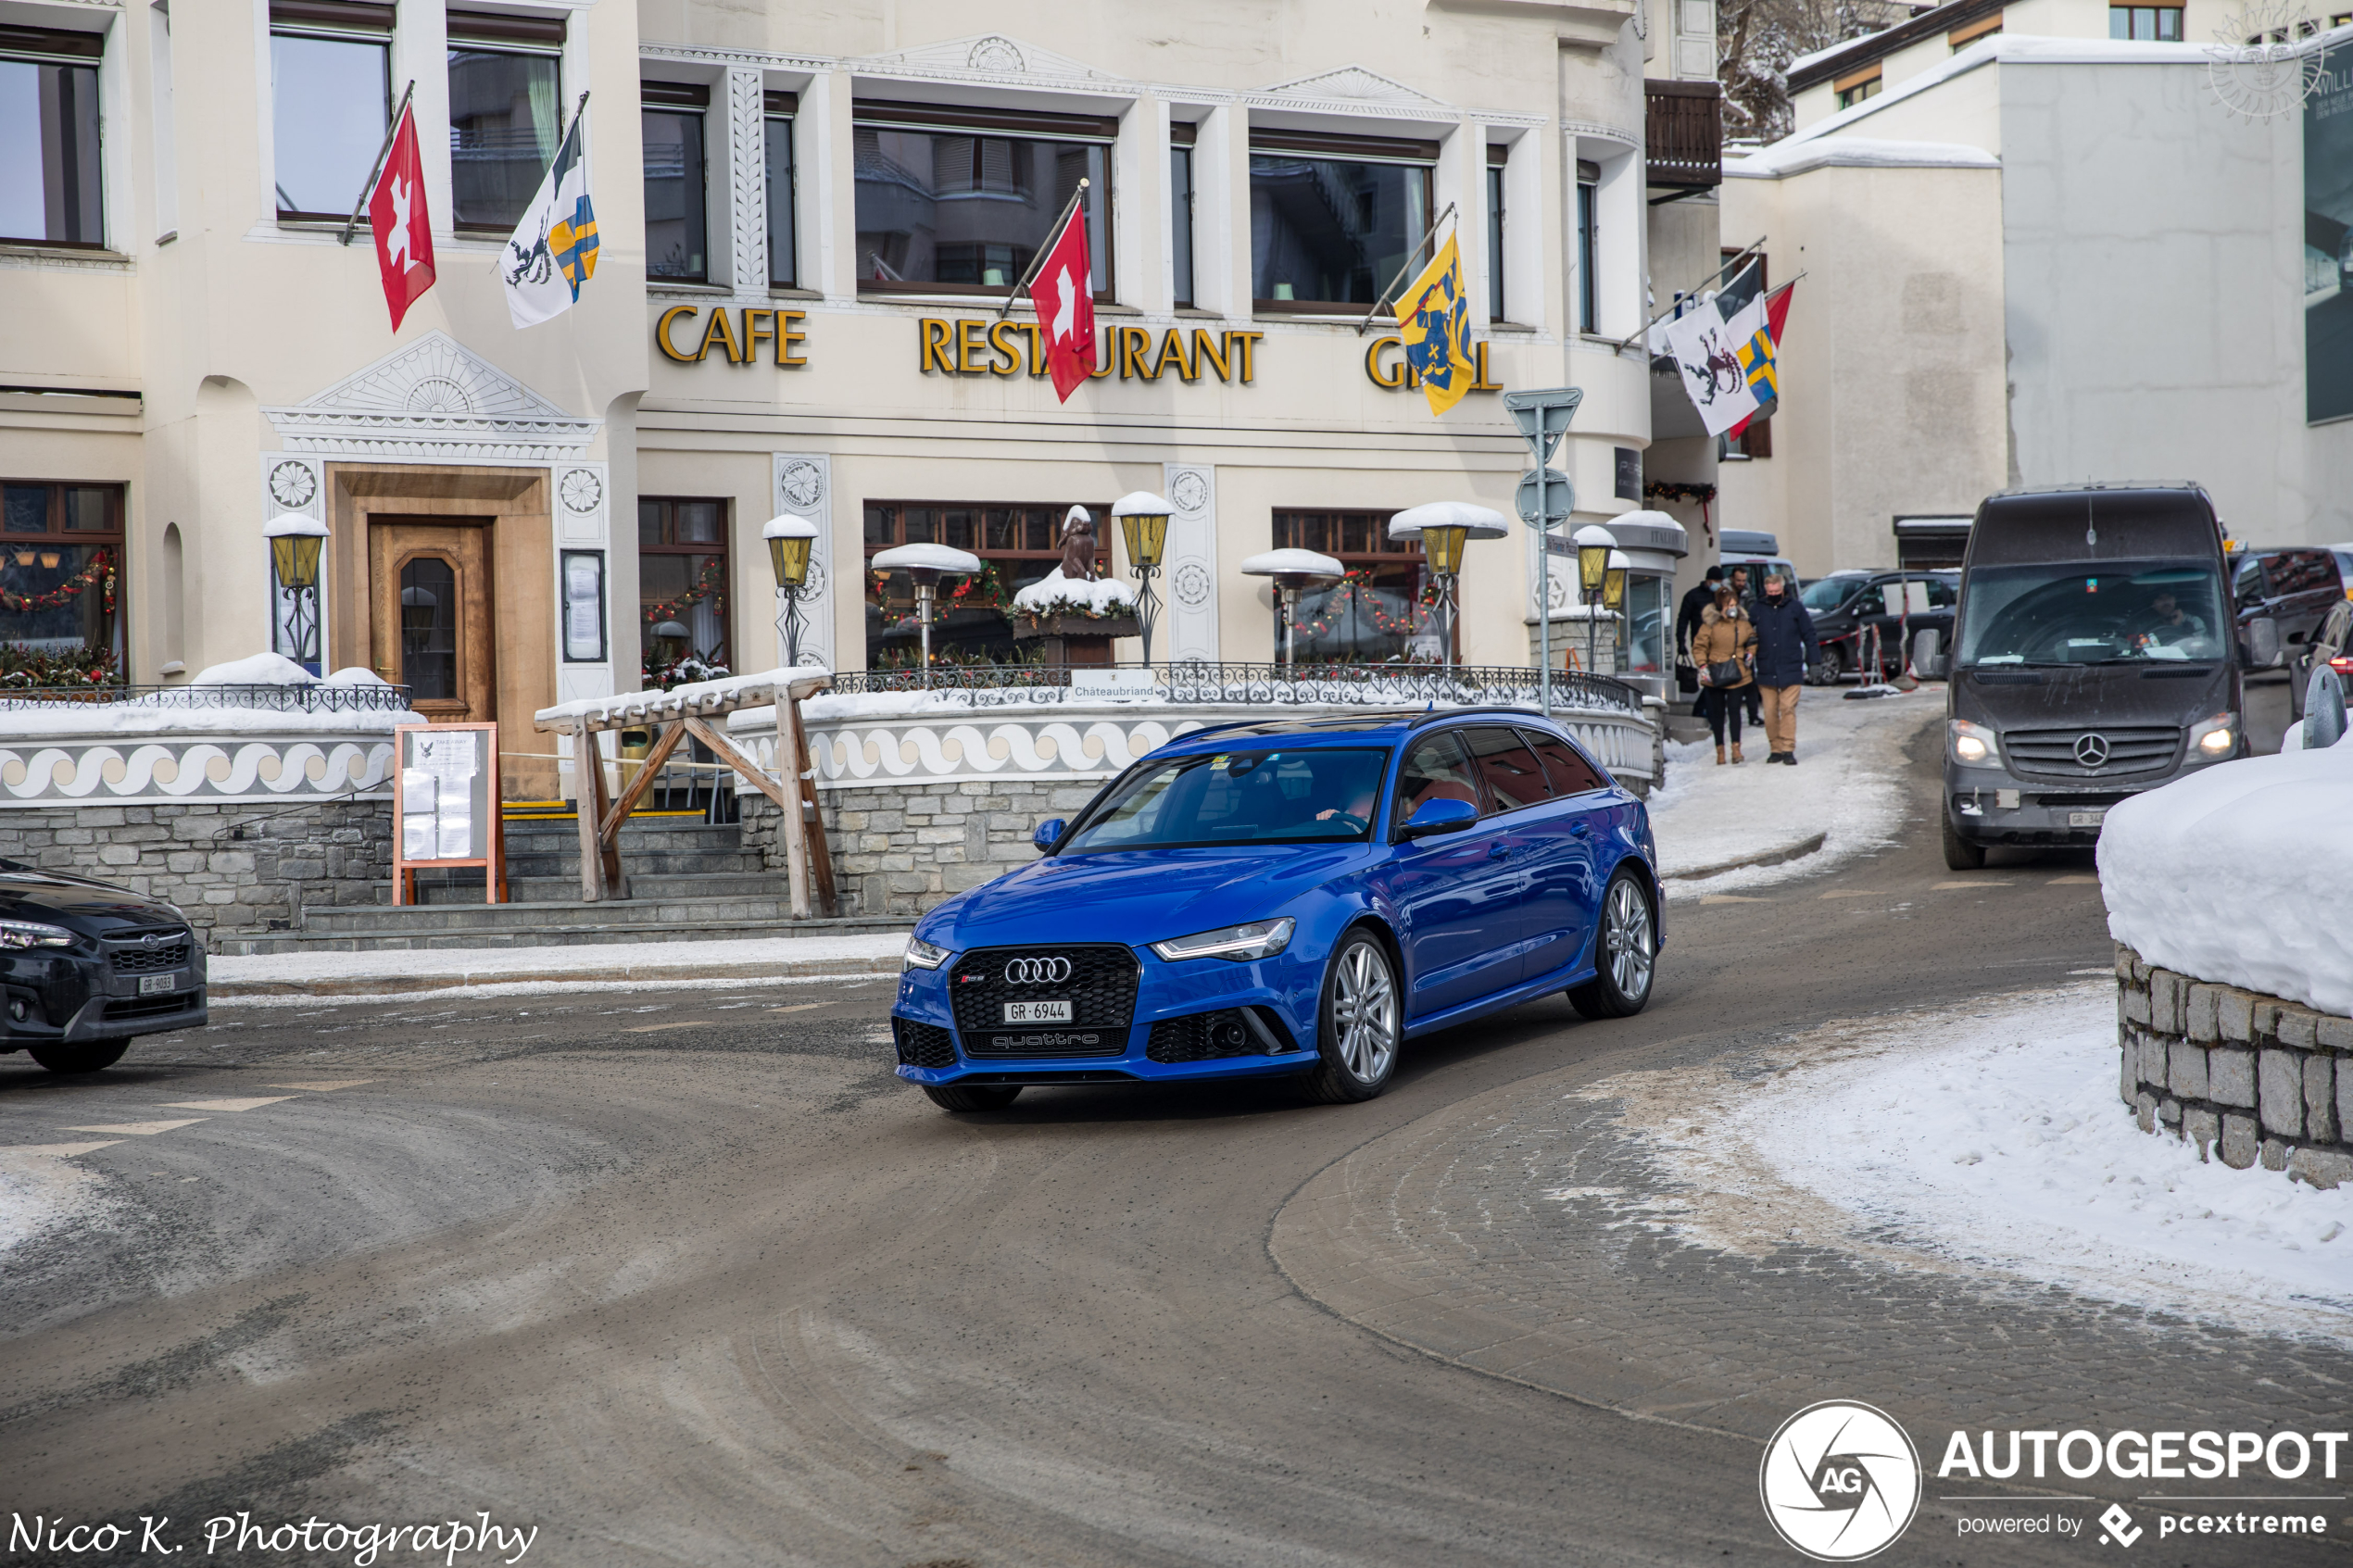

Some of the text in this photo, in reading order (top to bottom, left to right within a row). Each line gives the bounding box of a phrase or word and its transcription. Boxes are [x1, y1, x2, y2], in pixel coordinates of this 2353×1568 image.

[655, 305, 808, 365] CAFE
[1075, 686, 1154, 696] Châteaubriand
[992, 1033, 1100, 1049] quattro
